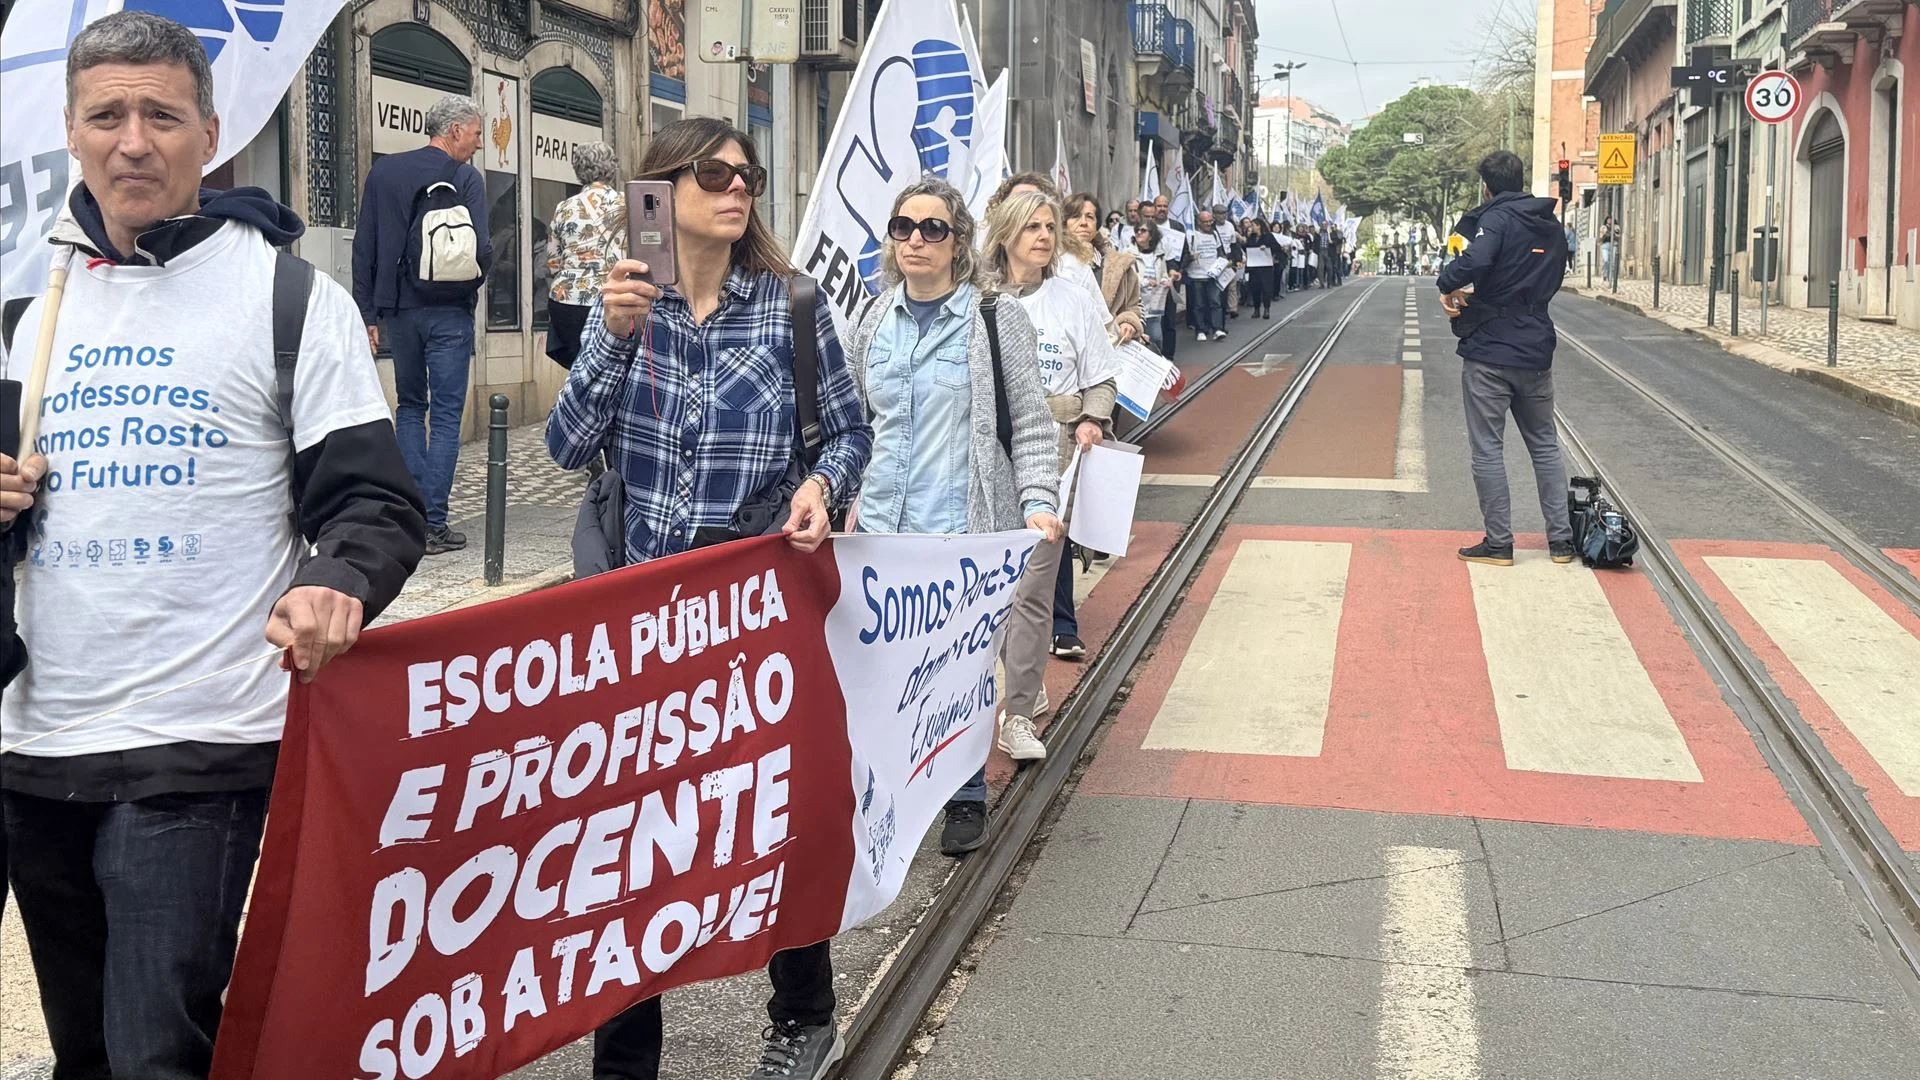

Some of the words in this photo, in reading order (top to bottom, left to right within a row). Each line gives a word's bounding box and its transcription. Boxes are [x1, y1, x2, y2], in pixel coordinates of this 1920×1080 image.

[1756, 88, 1791, 107] 30
[535, 134, 568, 162] PARA
[805, 229, 868, 320] FEN
[65, 343, 176, 372] Somos
[1039, 359, 1063, 371] osto
[40, 381, 220, 417] rofessores.
[33, 425, 111, 456] amos
[121, 416, 229, 449] Rosto
[46, 470, 62, 492] o
[71, 456, 196, 490] Futuro!
[859, 566, 955, 645] Somos
[405, 622, 619, 740] ESCOLA
[631, 569, 789, 676] PÚBLICA
[978, 668, 997, 712] Va
[378, 764, 446, 851] E
[455, 651, 795, 834] PROFISSÃO
[365, 743, 798, 998] DOCENTE
[358, 972, 488, 1080] SOB
[500, 861, 786, 1033] ATAQUE!
